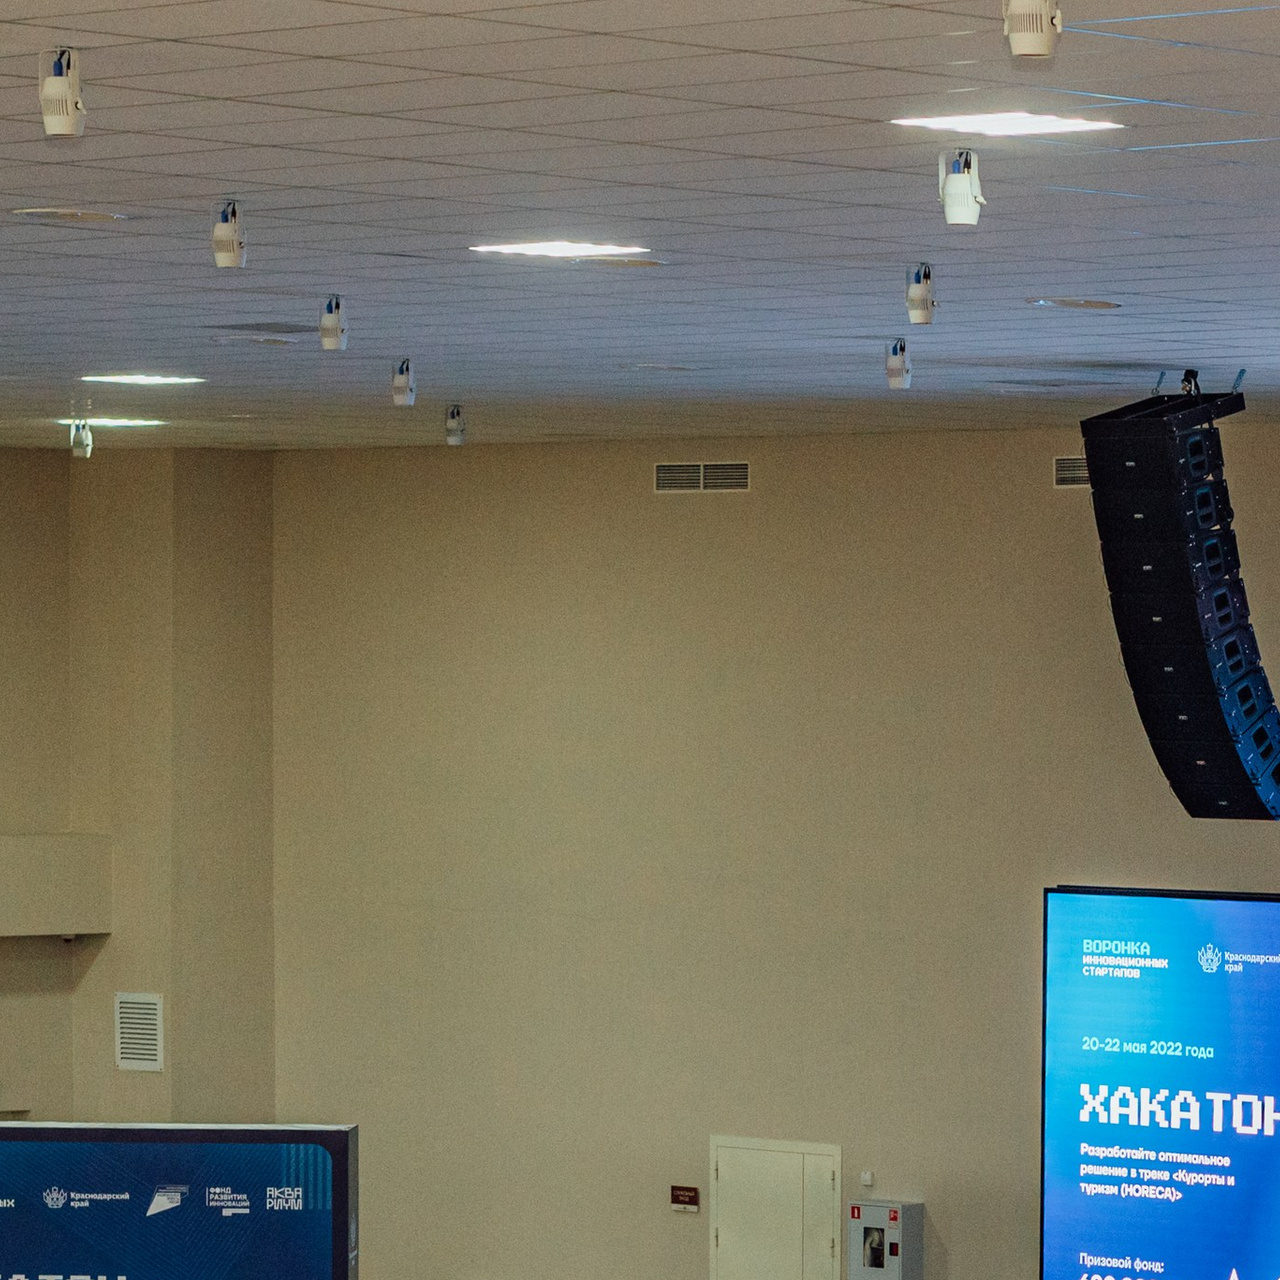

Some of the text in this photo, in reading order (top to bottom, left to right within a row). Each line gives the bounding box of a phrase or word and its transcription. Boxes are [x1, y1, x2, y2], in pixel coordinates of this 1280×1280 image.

[1082, 939, 1150, 955] ВОРОНКА
[1082, 954, 1169, 968] ИННОВАЦИОННЫХ
[1224, 962, 1243, 974] край
[1082, 966, 1140, 979] СТАРТАПОВ
[1082, 1036, 1214, 1059] 20-22 мая 2022 года
[1080, 1142, 1230, 1167] Разработайте оптимальное
[1079, 1163, 1235, 1186] решение в треке <Курорты и
[70, 1191, 130, 1201] Краснодарский
[1079, 1182, 1118, 1196] туризм
[70, 1201, 89, 1209] край
[1079, 1252, 1164, 1272] Призовой фонд:
